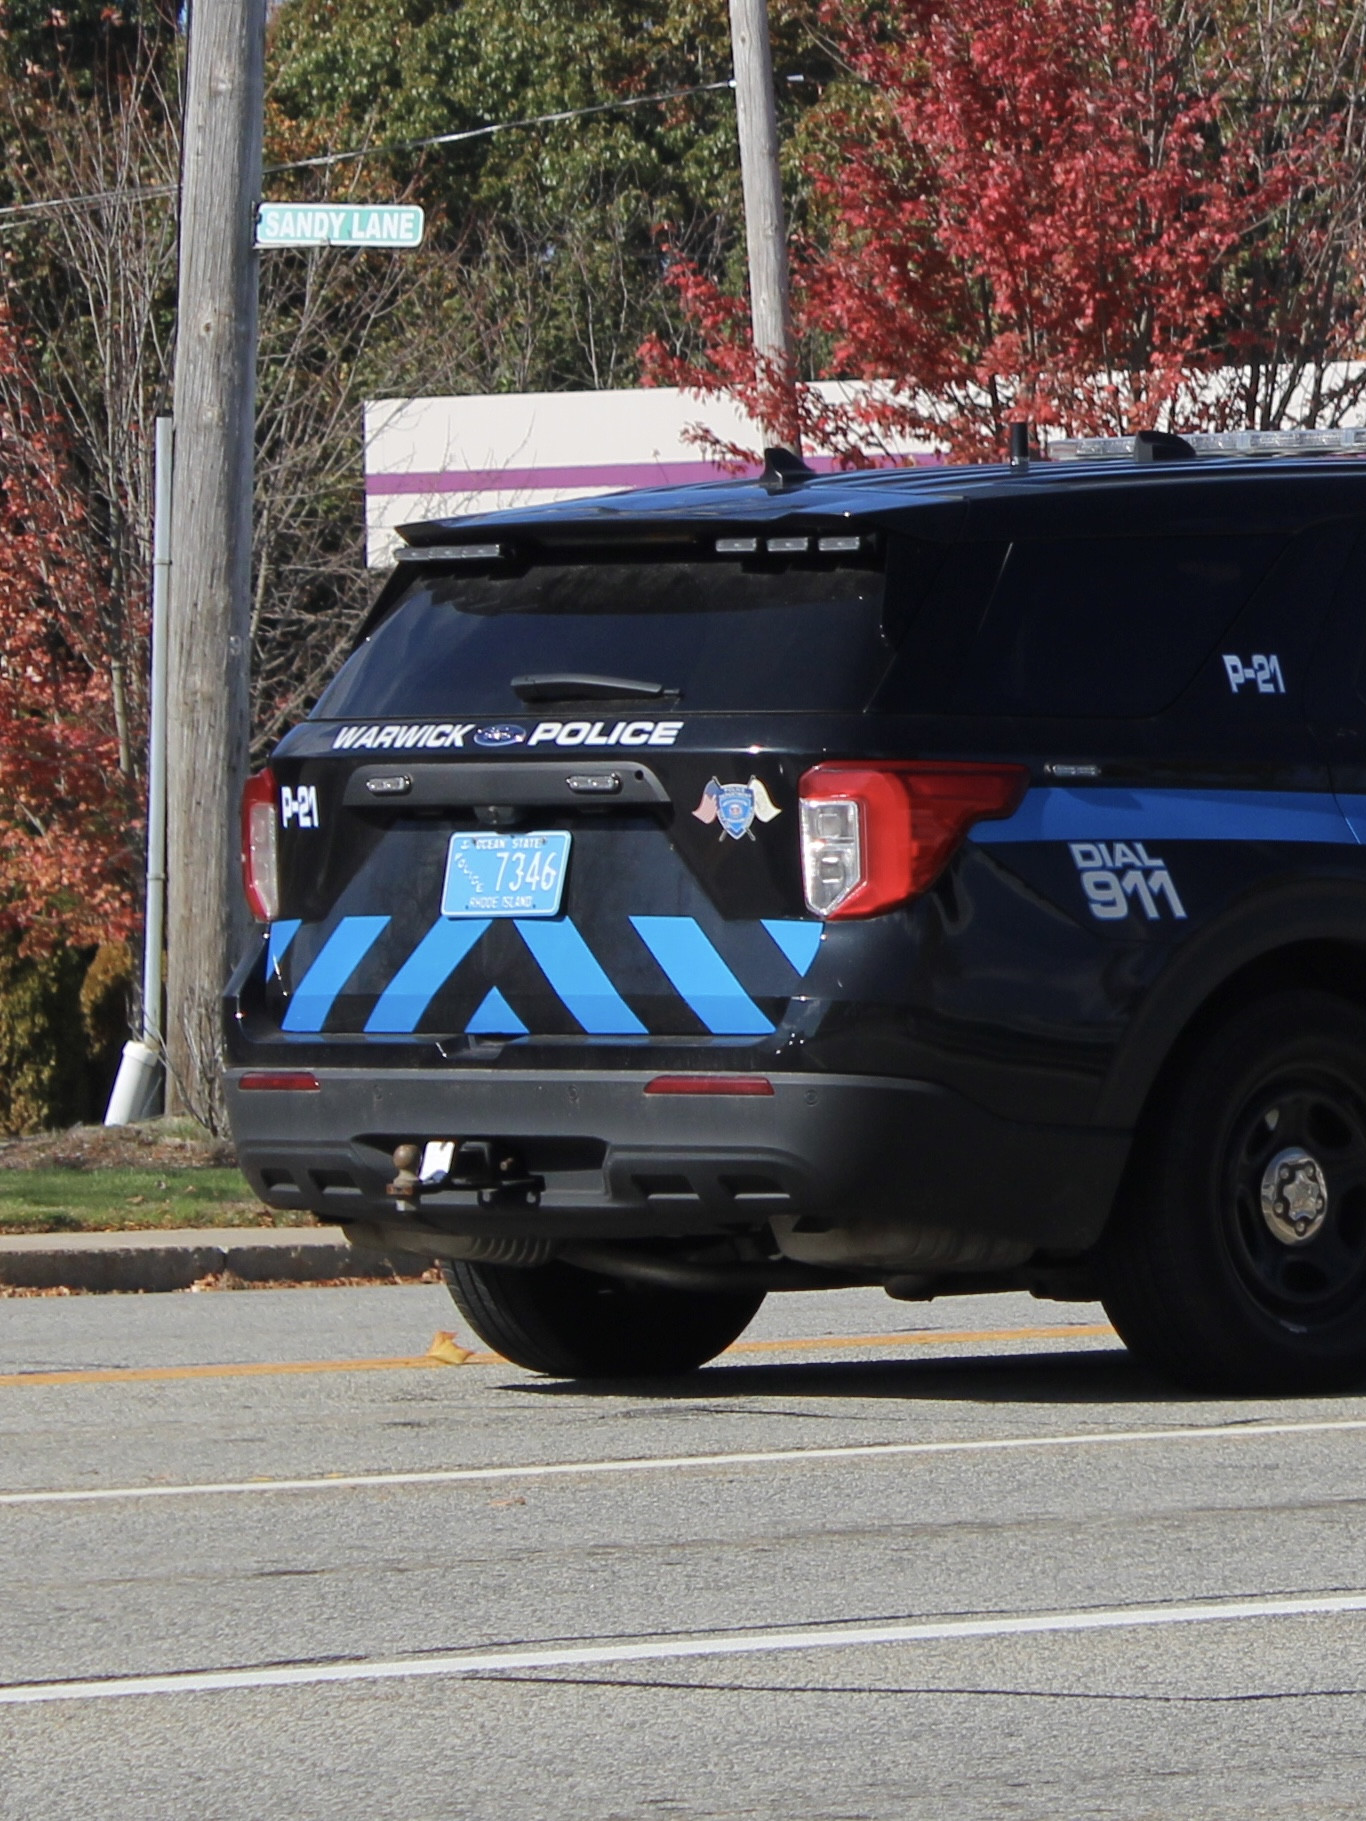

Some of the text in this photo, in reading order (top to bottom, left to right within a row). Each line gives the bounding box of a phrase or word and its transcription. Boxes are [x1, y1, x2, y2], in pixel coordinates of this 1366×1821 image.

[265, 211, 415, 239] SANDY LANE
[1222, 654, 1286, 693] P-21
[332, 724, 476, 749] WARWICK
[527, 721, 684, 746] POLICE
[281, 785, 319, 828] P-21
[475, 837, 542, 850] OCEAN STATE
[1068, 842, 1166, 869] DIAL
[496, 851, 557, 892] 7346
[469, 896, 534, 908] RHODE ISLAND
[1080, 869, 1188, 920] 911
